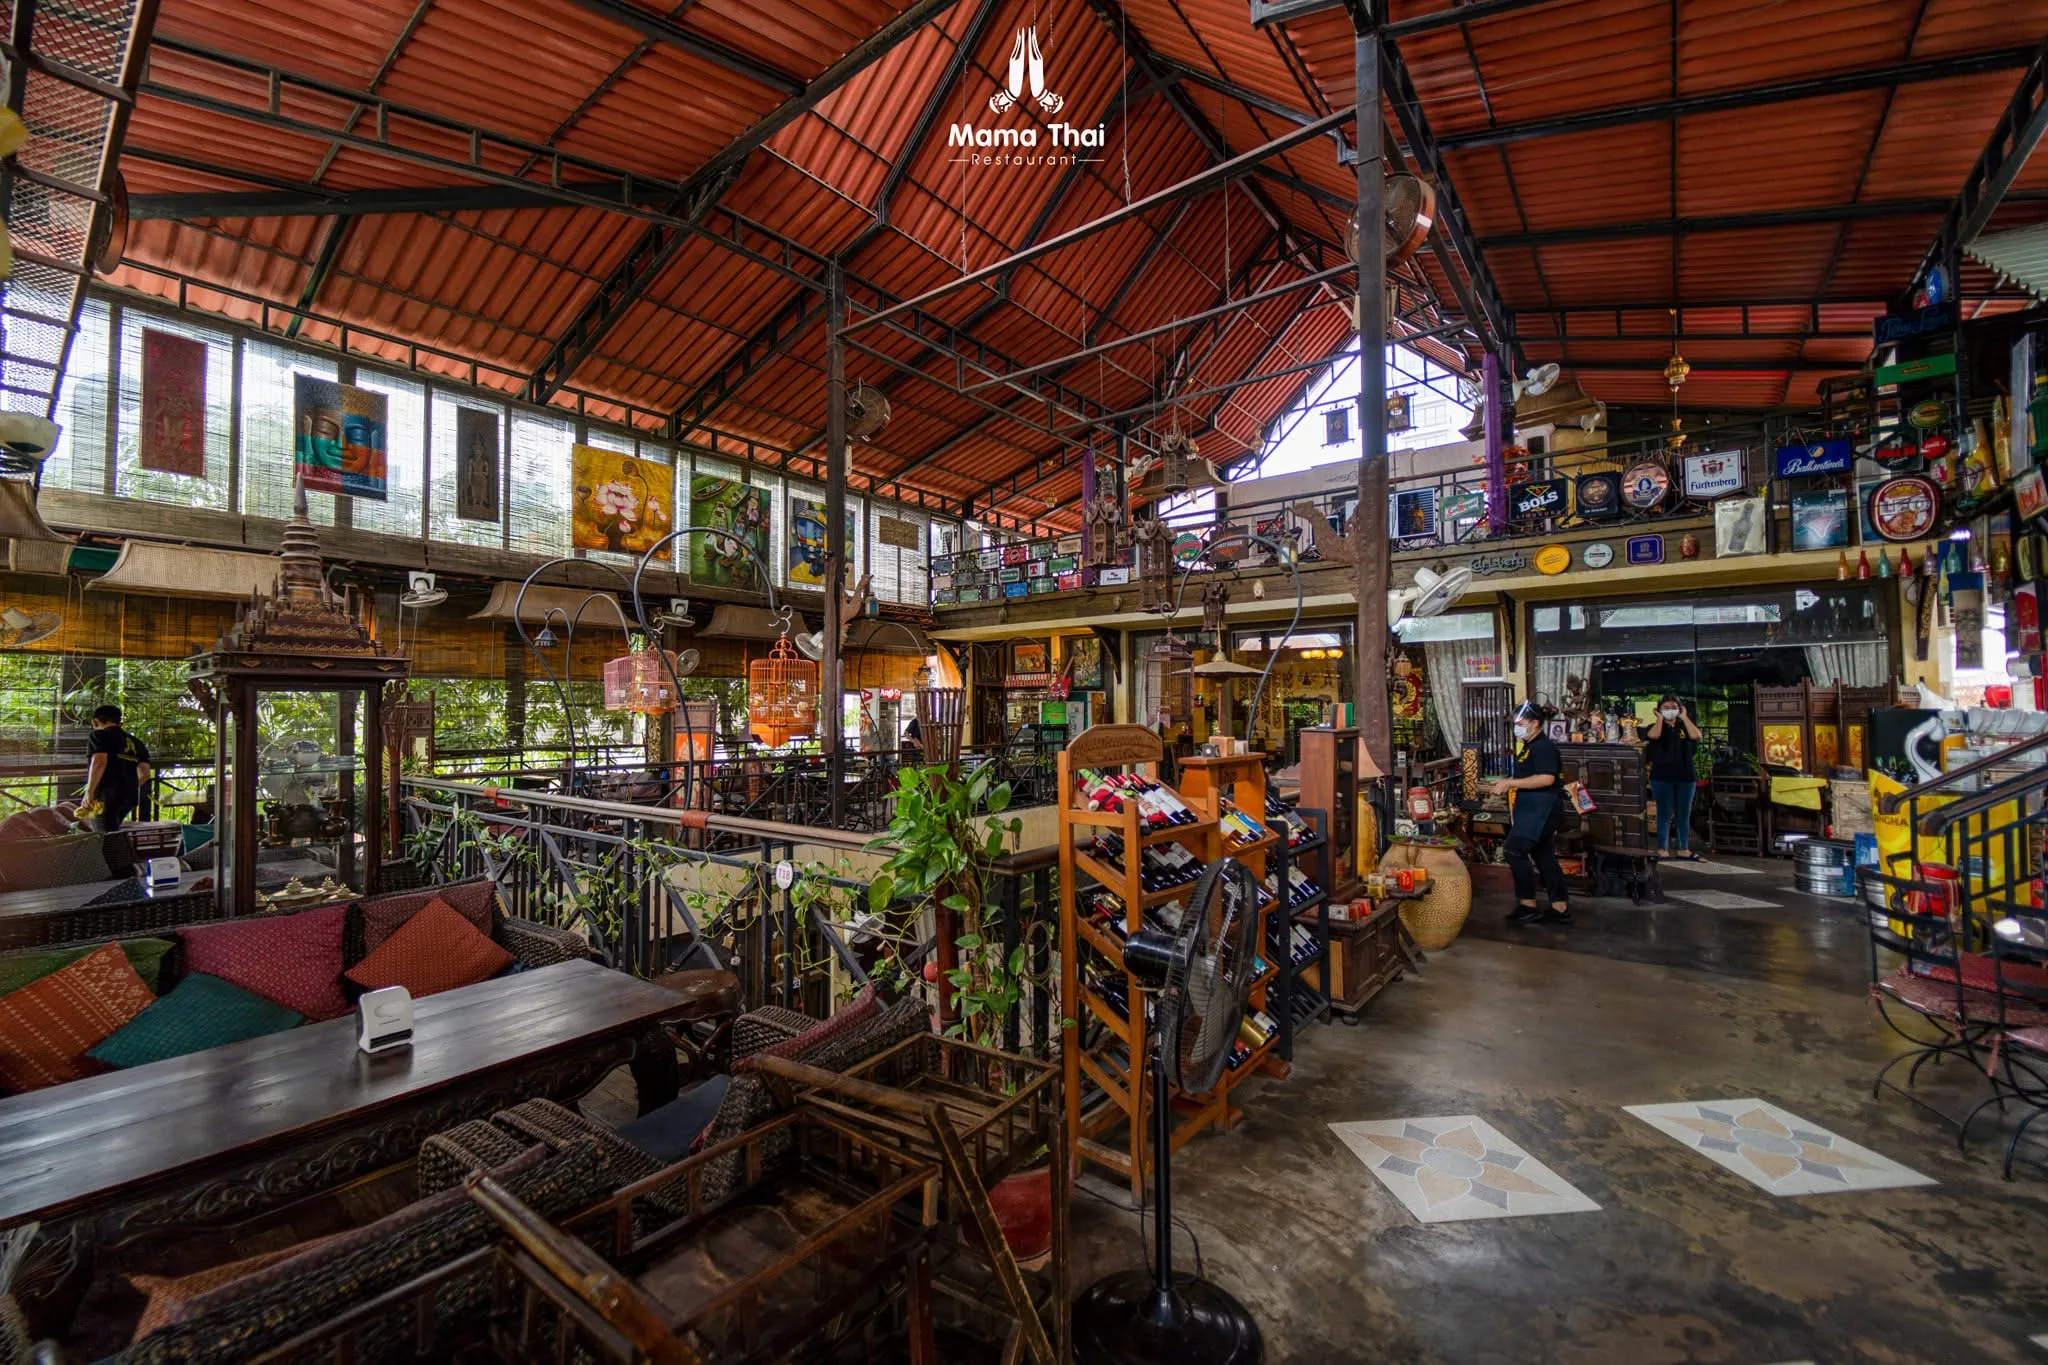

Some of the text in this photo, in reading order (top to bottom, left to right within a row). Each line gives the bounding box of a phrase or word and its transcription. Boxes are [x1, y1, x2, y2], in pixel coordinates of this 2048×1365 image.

[1518, 490, 1559, 513] BOLS
[1471, 551, 1527, 574] Carlsberg
[1466, 657, 1483, 665] Red
